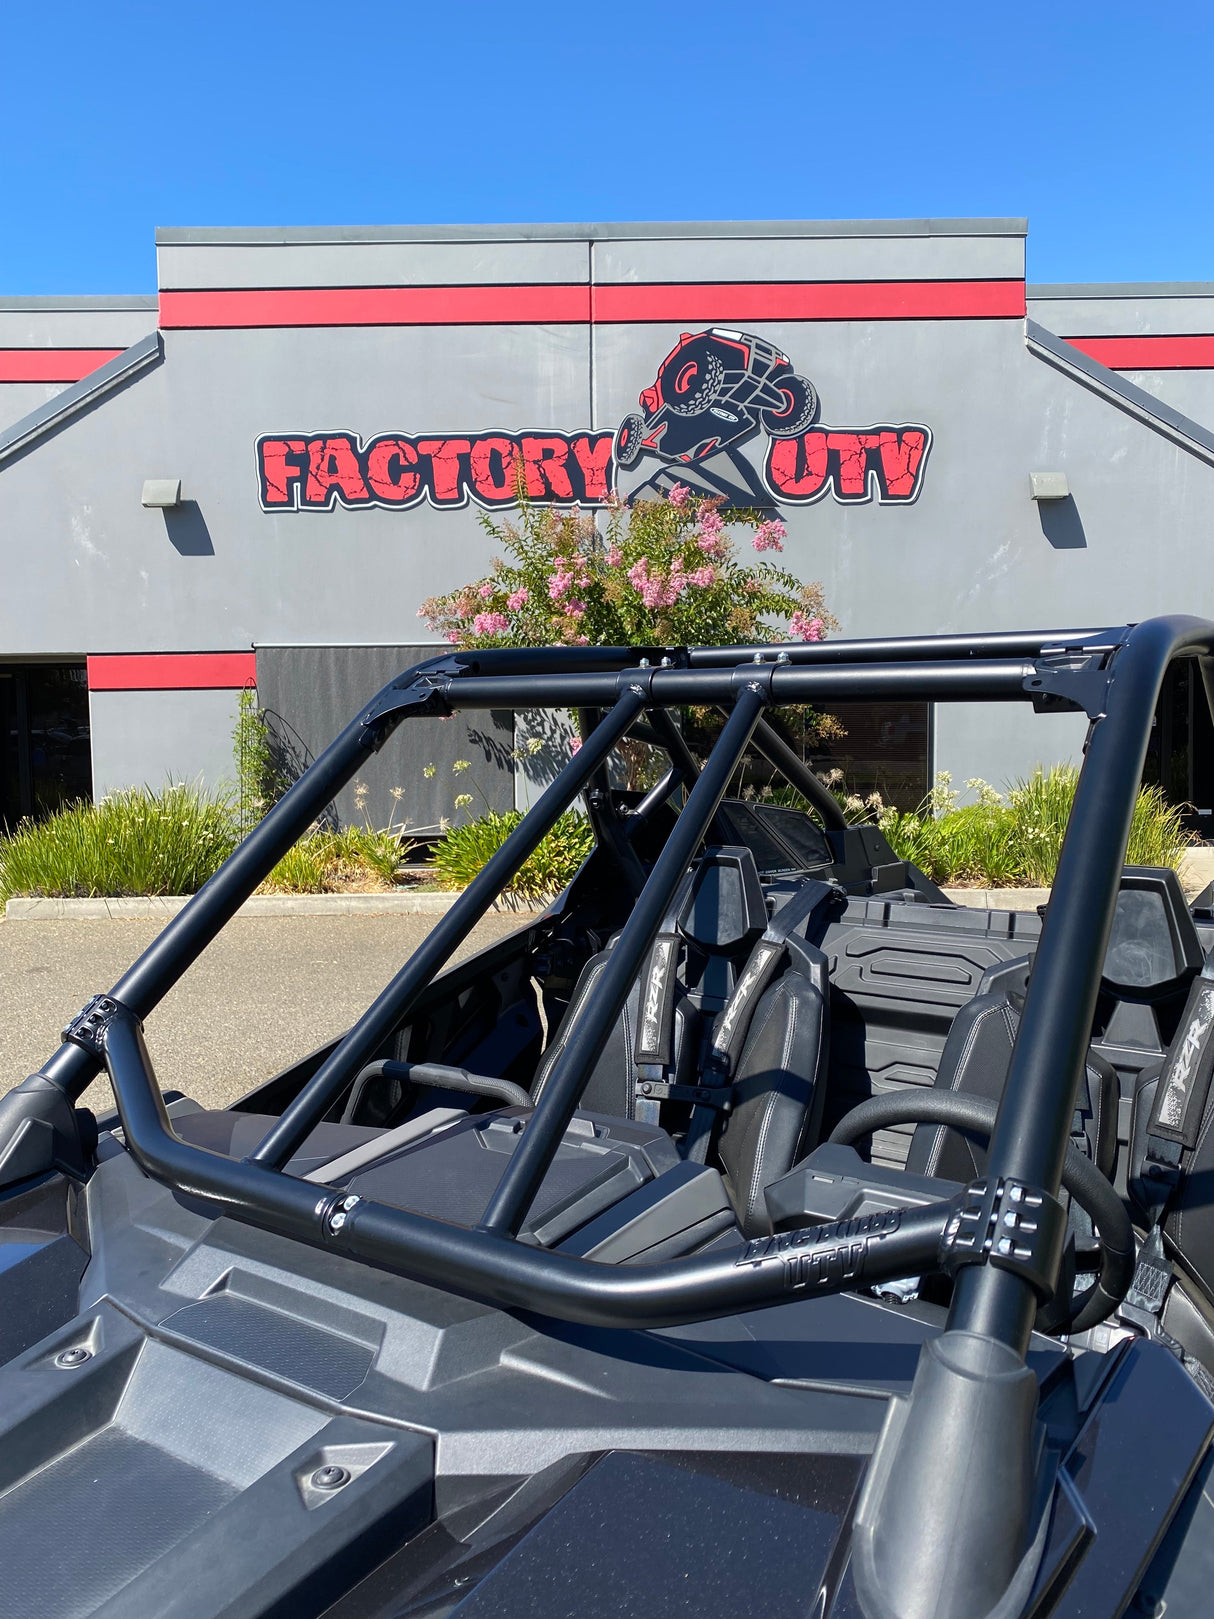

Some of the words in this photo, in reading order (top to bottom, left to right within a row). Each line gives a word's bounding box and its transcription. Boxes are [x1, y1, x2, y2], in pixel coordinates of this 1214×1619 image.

[263, 437, 614, 502] FACTORY
[771, 432, 926, 496] UTV
[645, 965, 666, 1024] RZR
[723, 972, 756, 1031] RZR
[1174, 1018, 1205, 1092] RZR
[787, 1243, 864, 1290] UTV
